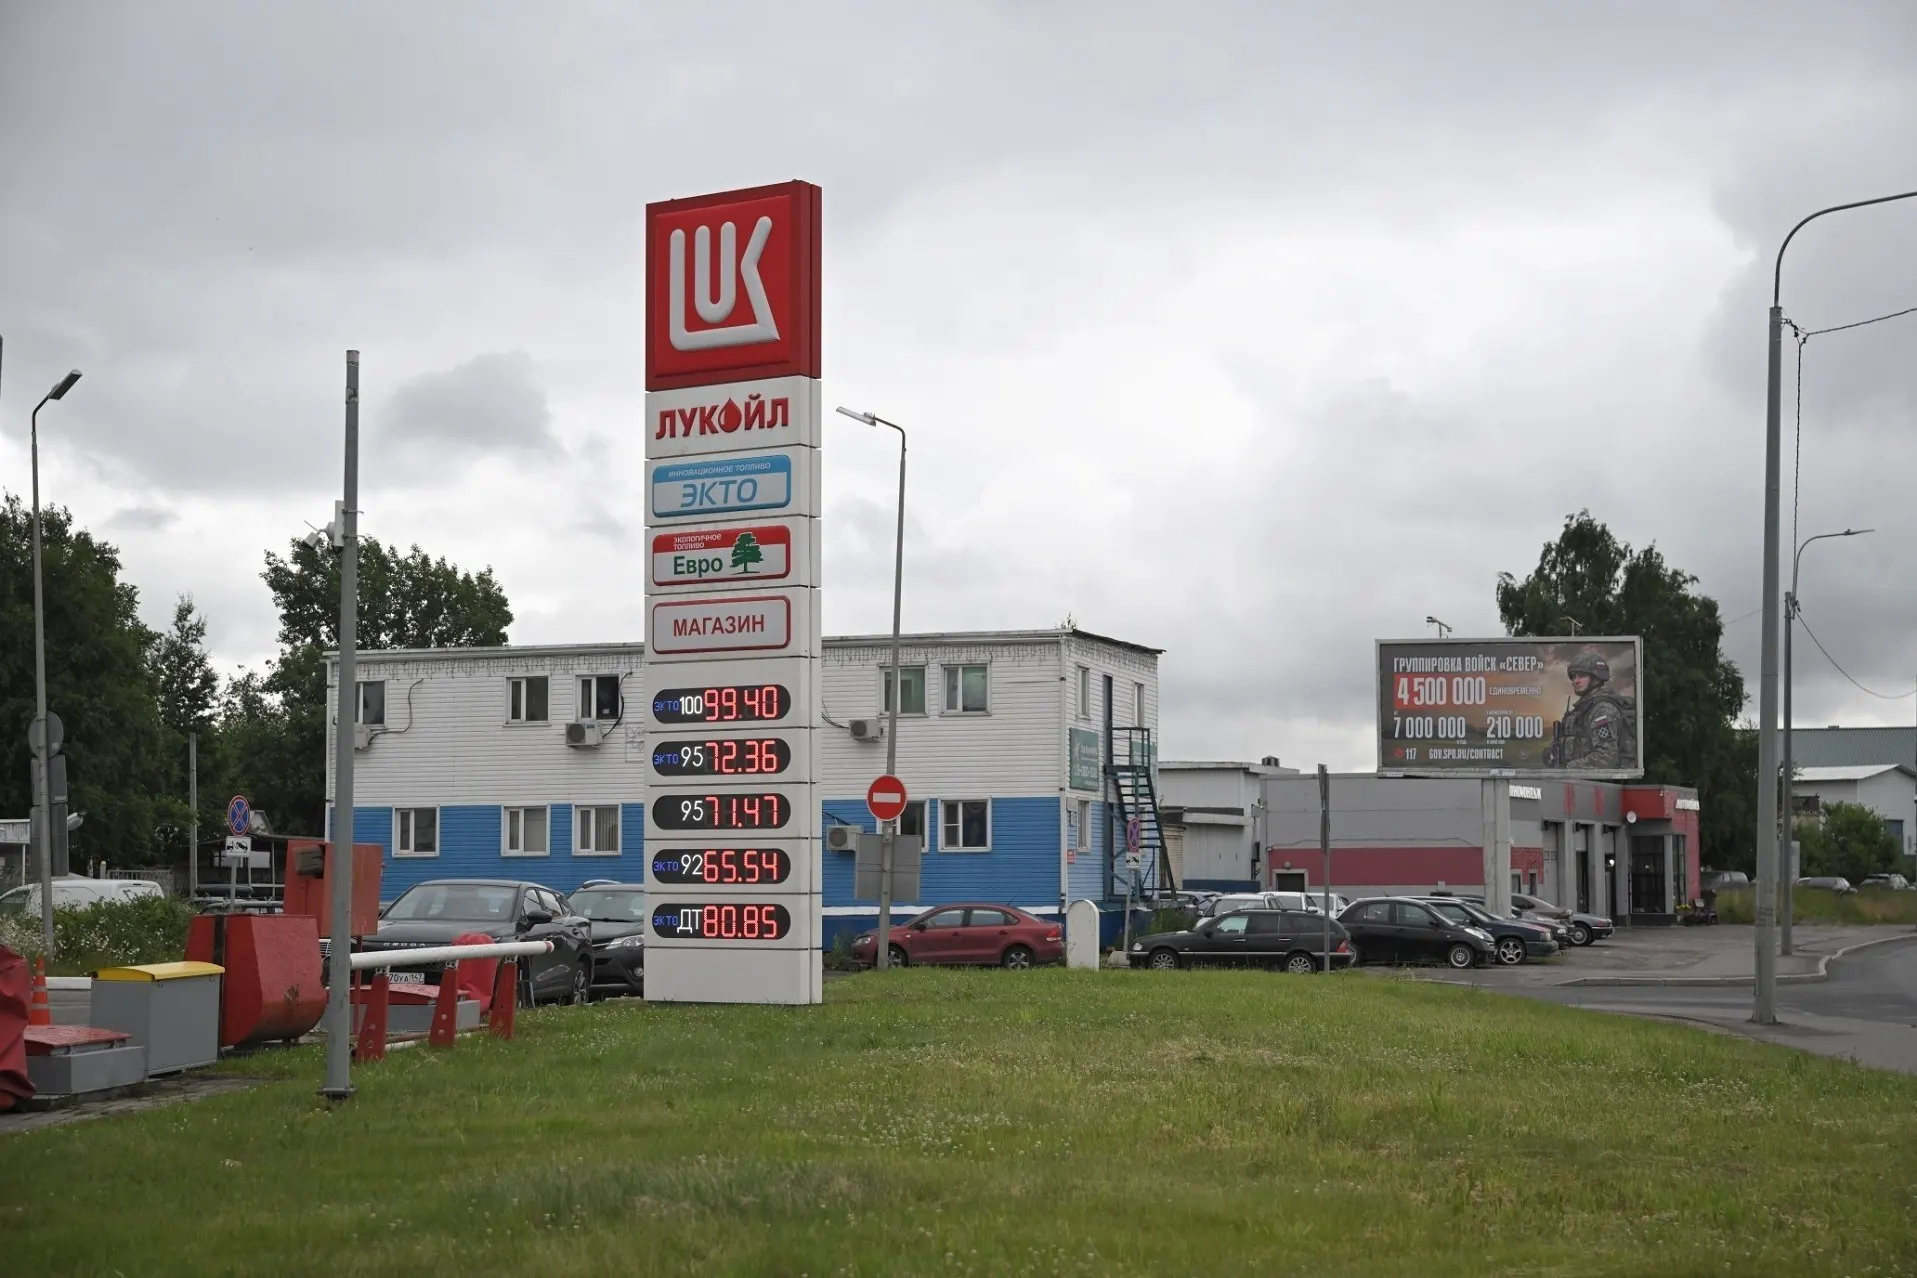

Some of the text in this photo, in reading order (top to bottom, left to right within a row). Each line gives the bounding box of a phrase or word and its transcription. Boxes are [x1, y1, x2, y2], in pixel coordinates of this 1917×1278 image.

[668, 462, 771, 478] ИННОВАЦИОННОЕ ТОПЛИВО
[680, 478, 758, 508] ЭКТО
[673, 555, 724, 579] Евро
[673, 614, 765, 637] МАГАЗИН
[1393, 654, 1544, 673] ГРУППИРОВКА ВОЙСК «СЕВЕР»
[1397, 676, 1486, 706] 4 500 000
[1489, 686, 1542, 696] ЕДИНОВРЕМЕННО
[653, 700, 679, 711] ЭКТО
[679, 696, 703, 715] 100
[1393, 716, 1466, 739] 7 000 000
[1486, 716, 1544, 739] 210 000
[653, 740, 777, 773] ЭКТО 95 72.36
[1405, 748, 1417, 760] 117
[680, 796, 777, 828] 95 71.47
[653, 851, 777, 882] ЭКТО 92 65.54
[653, 905, 777, 938] ЭКТО ДТ 80.85
